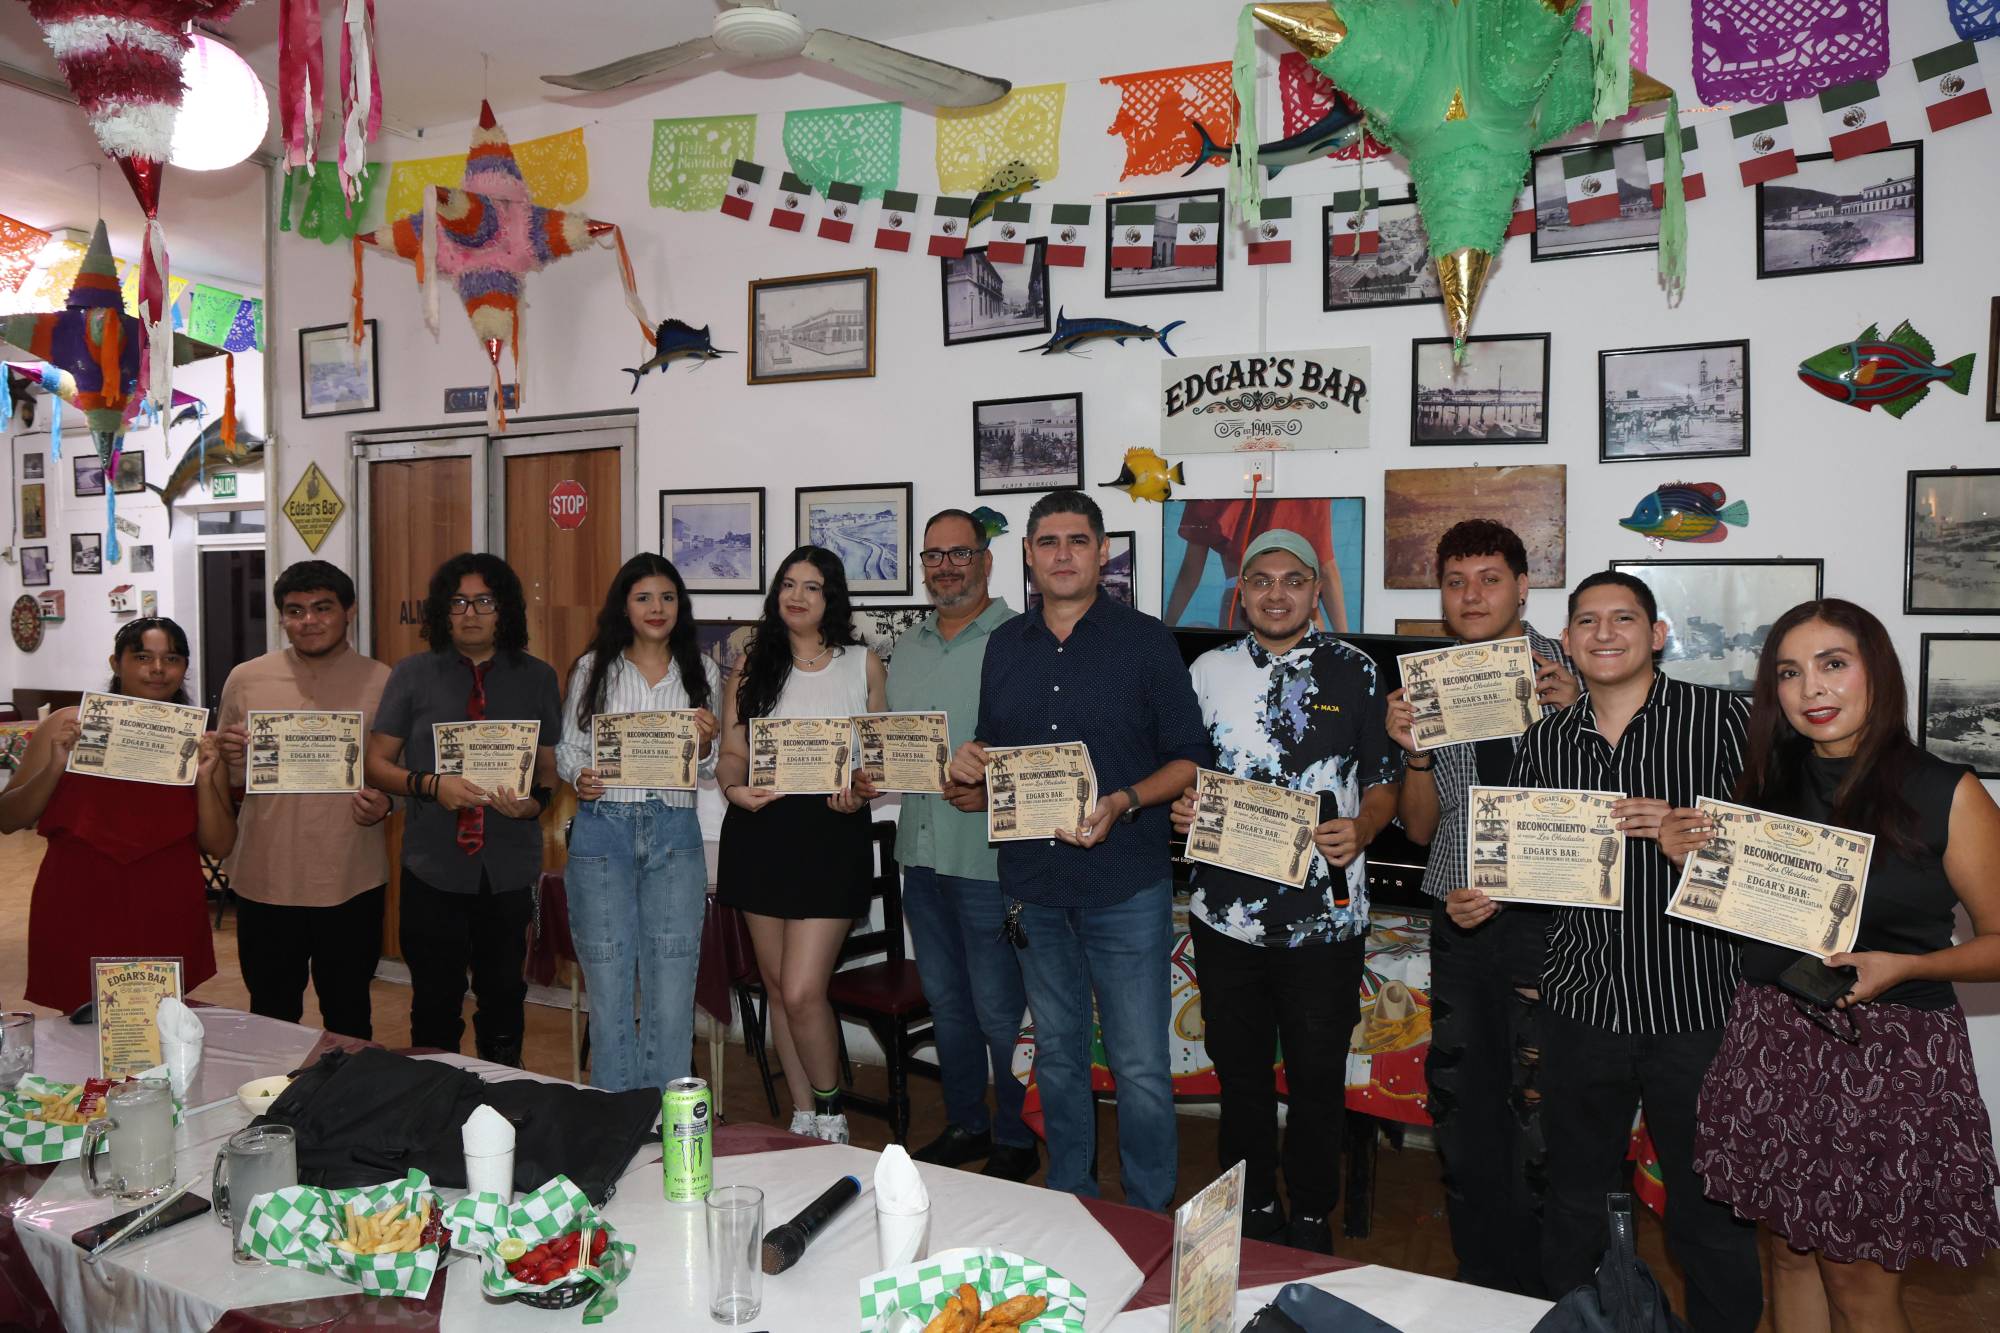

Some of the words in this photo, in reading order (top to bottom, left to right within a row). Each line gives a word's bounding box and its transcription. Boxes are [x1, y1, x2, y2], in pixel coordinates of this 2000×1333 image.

[1164, 356, 1295, 417] EDGAR'S
[1299, 361, 1368, 414] BAR
[213, 477, 236, 494] SALIDA
[322, 499, 338, 515] Bar
[552, 495, 584, 515] STOP
[1509, 659, 1517, 667] 77
[1443, 670, 1501, 686] RECONOCIMIENTO
[1452, 695, 1482, 705] EDGAR'S
[120, 719, 176, 734] RECONOCIMIENTO
[627, 731, 675, 739] RECONOCIMIENTO
[886, 734, 928, 742] RECONOCIMIENTO
[122, 738, 149, 747] EDGAR'S
[1019, 770, 1066, 780] RECONOCIMIENTO
[1026, 792, 1050, 800] EDGAR'S
[1233, 800, 1289, 820] RECONOCIMIENTO
[1236, 822, 1264, 835] EDGAR'S
[1517, 821, 1586, 833] RECONOCIMIENTO
[1523, 847, 1557, 856] EDGAR'S
[1743, 845, 1823, 873] RECONOCIMIENTO
[1837, 856, 1849, 867] 77
[1781, 867, 1819, 883] Olvidados
[1746, 874, 1784, 892] EDGAR'S
[107, 971, 146, 987] EDGAR'S
[147, 972, 167, 985] BAR
